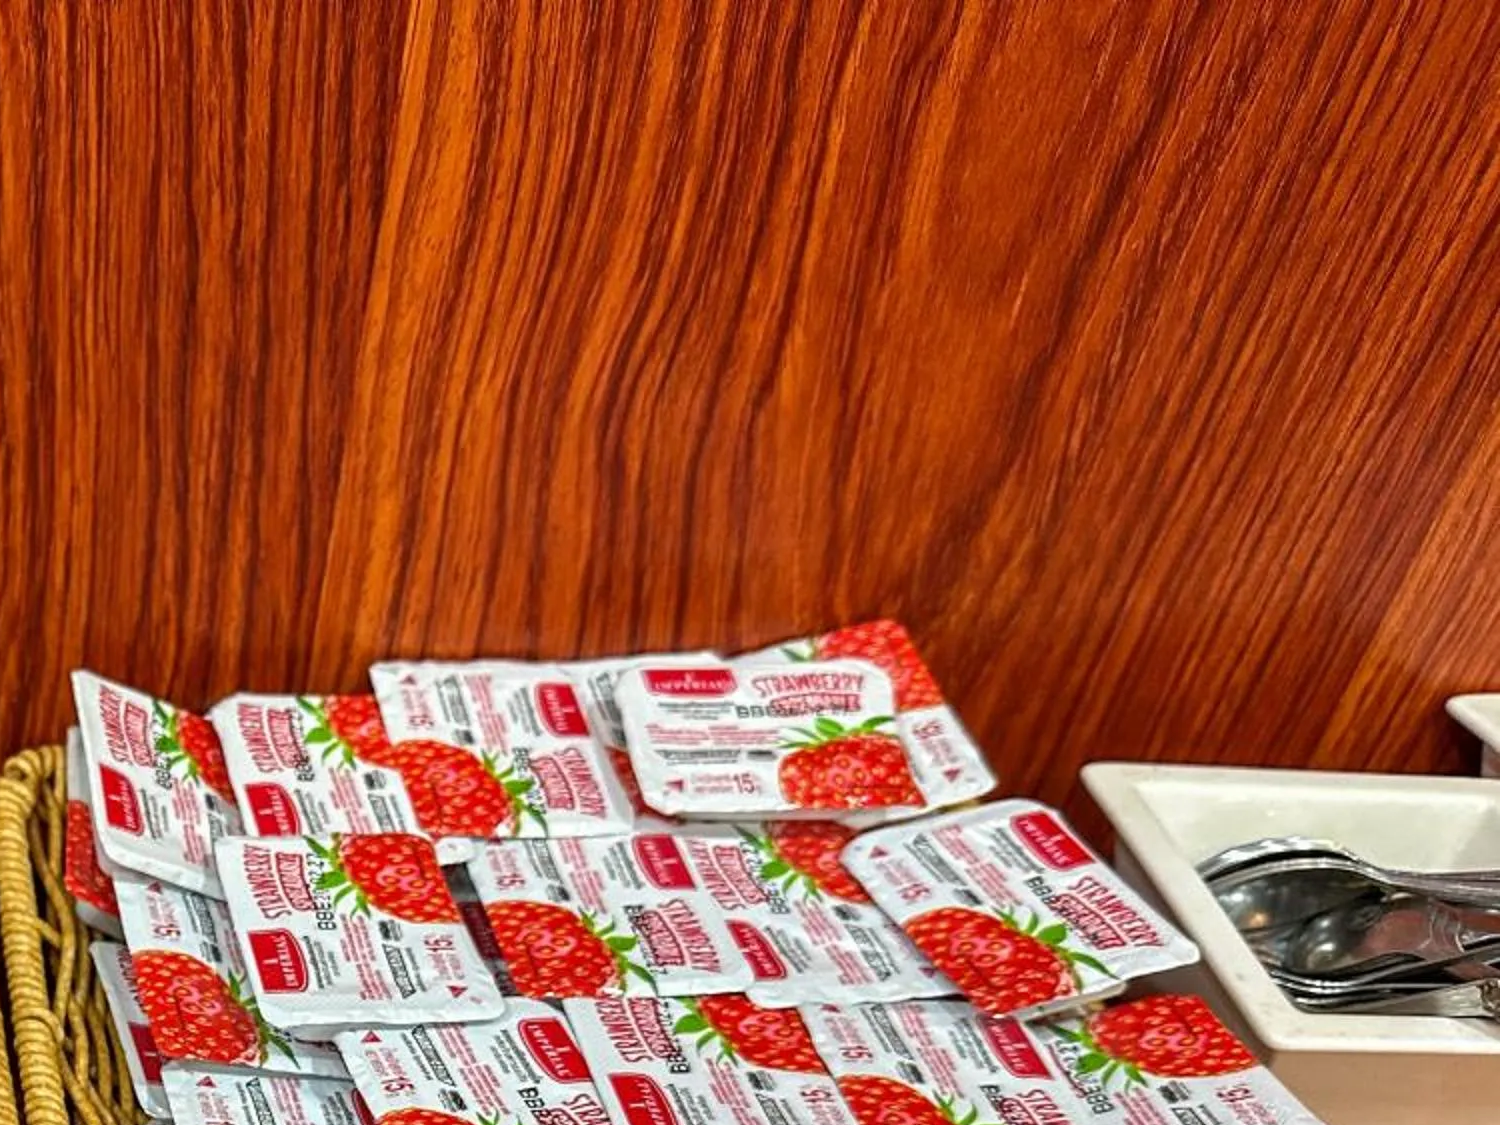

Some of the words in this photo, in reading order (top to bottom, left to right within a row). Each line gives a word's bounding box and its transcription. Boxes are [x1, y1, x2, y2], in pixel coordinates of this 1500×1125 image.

[750, 674, 865, 699] STRAWBERRY
[733, 774, 757, 794] 15
[244, 845, 293, 920] STRAWBERRY
[1067, 876, 1166, 950] STRAWBERRY
[423, 934, 455, 951] 15
[656, 899, 722, 973] STRAWBERRY
[271, 935, 297, 986] IMPERIAL
[528, 1024, 573, 1079] IMPERIAL
[839, 1044, 873, 1062] 15
[381, 1077, 415, 1097] 15
[799, 1087, 832, 1101] 15
